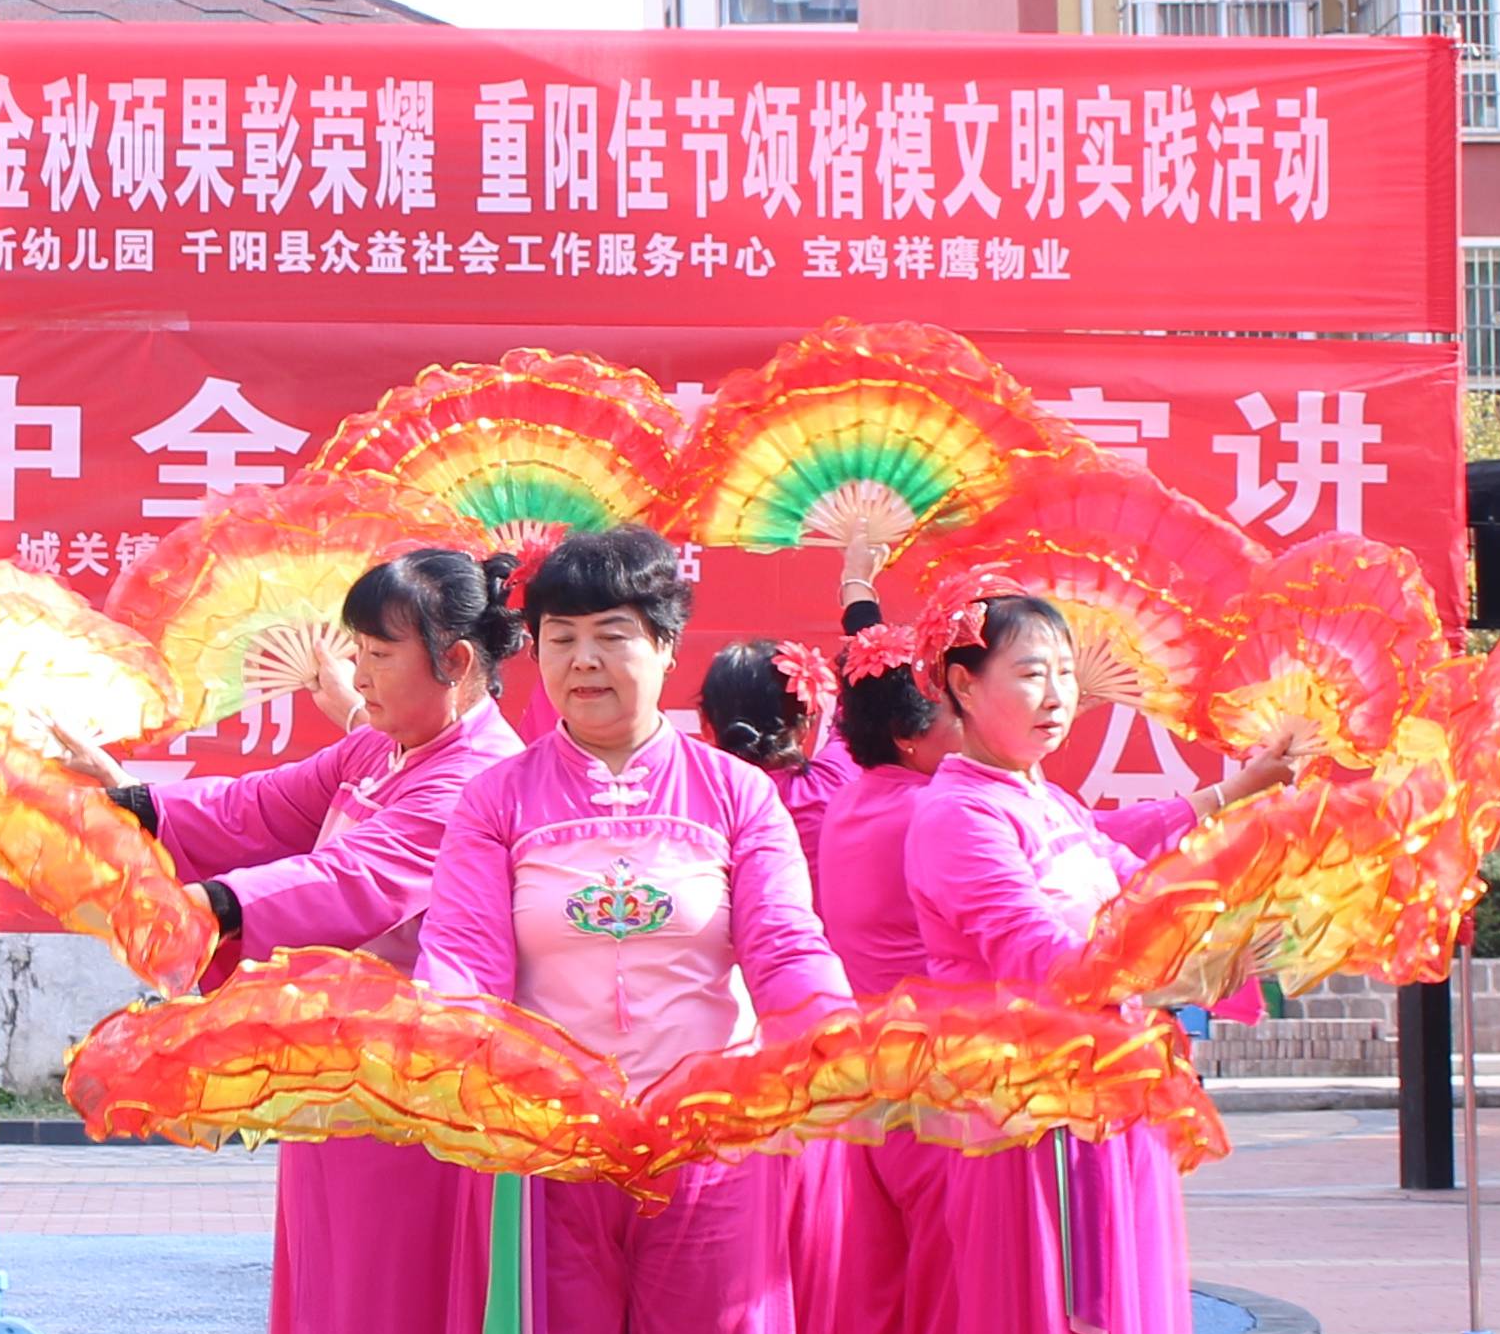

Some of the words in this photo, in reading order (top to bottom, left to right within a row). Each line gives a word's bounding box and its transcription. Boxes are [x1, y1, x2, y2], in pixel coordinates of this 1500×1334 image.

[474, 77, 1331, 225] 重阳佳节颂楷模文明实践活动
[181, 229, 778, 279] 千阳县众益社会工作服务中心
[803, 234, 1073, 282] 宝鸡祥鹰物业
